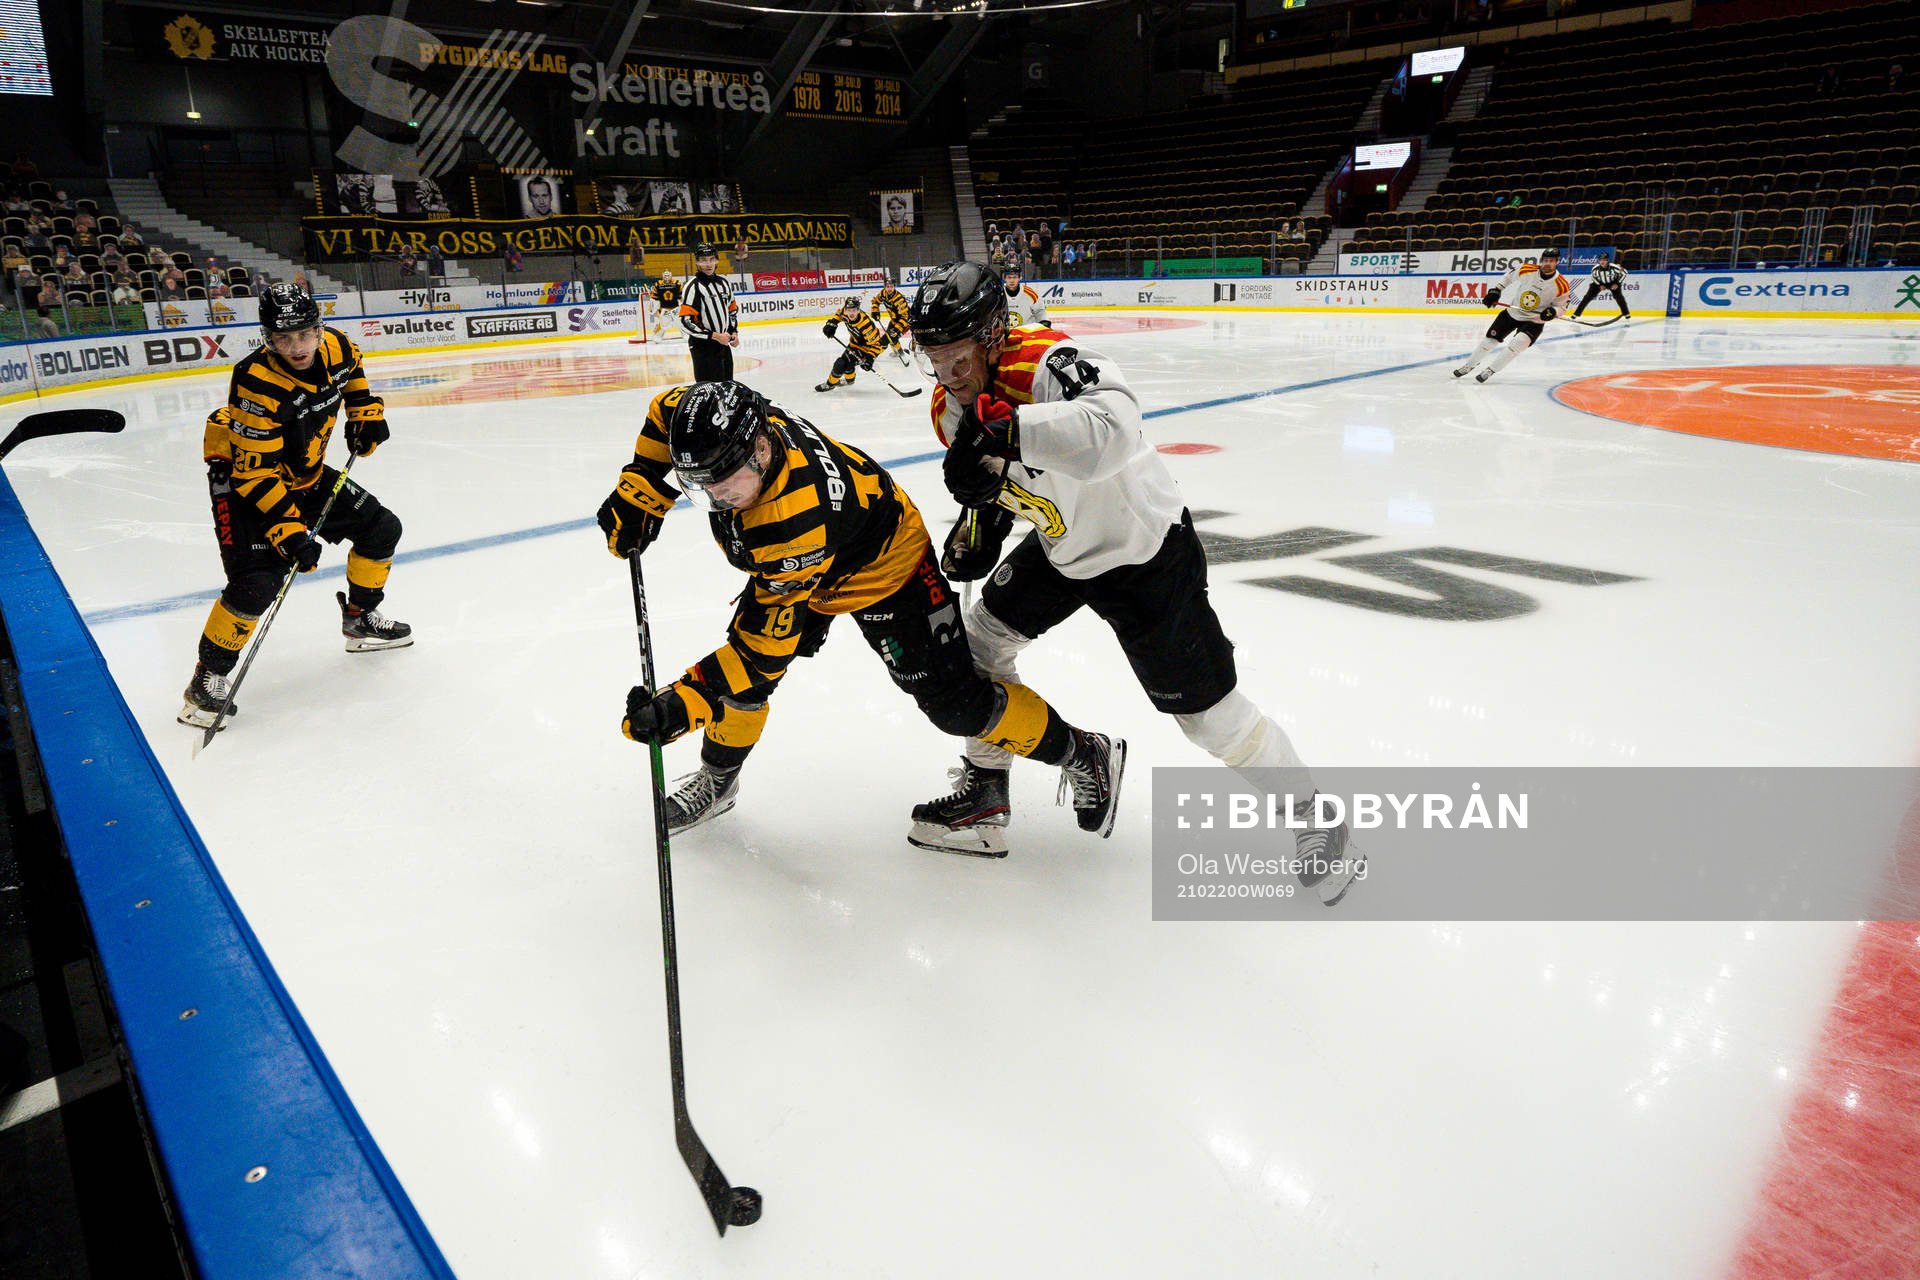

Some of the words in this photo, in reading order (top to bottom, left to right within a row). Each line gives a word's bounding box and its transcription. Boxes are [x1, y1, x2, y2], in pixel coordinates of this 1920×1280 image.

[223, 24, 331, 47] SKELLEFTEÅ
[230, 43, 259, 59] AIK
[265, 46, 331, 64] HOCKEY
[419, 42, 521, 70] BYGDENS
[527, 51, 568, 74] LAG
[624, 63, 689, 82] NORTH
[568, 62, 771, 113] Skellefteå
[793, 86, 821, 110] 1978
[834, 89, 863, 113] 2013
[875, 93, 901, 116] 2014
[574, 118, 681, 158] Kraft
[316, 229, 356, 255] VI
[362, 228, 428, 255] TAR
[438, 231, 498, 255] OSS
[502, 224, 621, 252] IGENOM
[628, 224, 688, 248] ALLT
[699, 221, 847, 246] TILLSAMMANS
[1351, 255, 1401, 268] SPORT
[1560, 255, 1599, 264] Nrrlands
[486, 288, 546, 299] Homlunds
[1240, 284, 1272, 293] FORDONS
[1296, 280, 1389, 292] SKIDSTAHUS
[1426, 279, 1488, 299] MAXI
[1735, 281, 1850, 297] extena
[1138, 292, 1152, 303] EY
[1240, 292, 1272, 301] MONTAGE
[602, 307, 637, 320] Skellefteå
[741, 300, 795, 314] HULTDINS
[383, 318, 455, 335] valutec
[471, 318, 534, 335] STAFFARE
[536, 317, 554, 330] AB
[603, 318, 622, 327] Kraft
[143, 335, 230, 367] BDX
[40, 345, 130, 376] BOLIDEN
[681, 451, 692, 463] 19
[761, 606, 795, 638] 19
[863, 612, 894, 622] CCM
